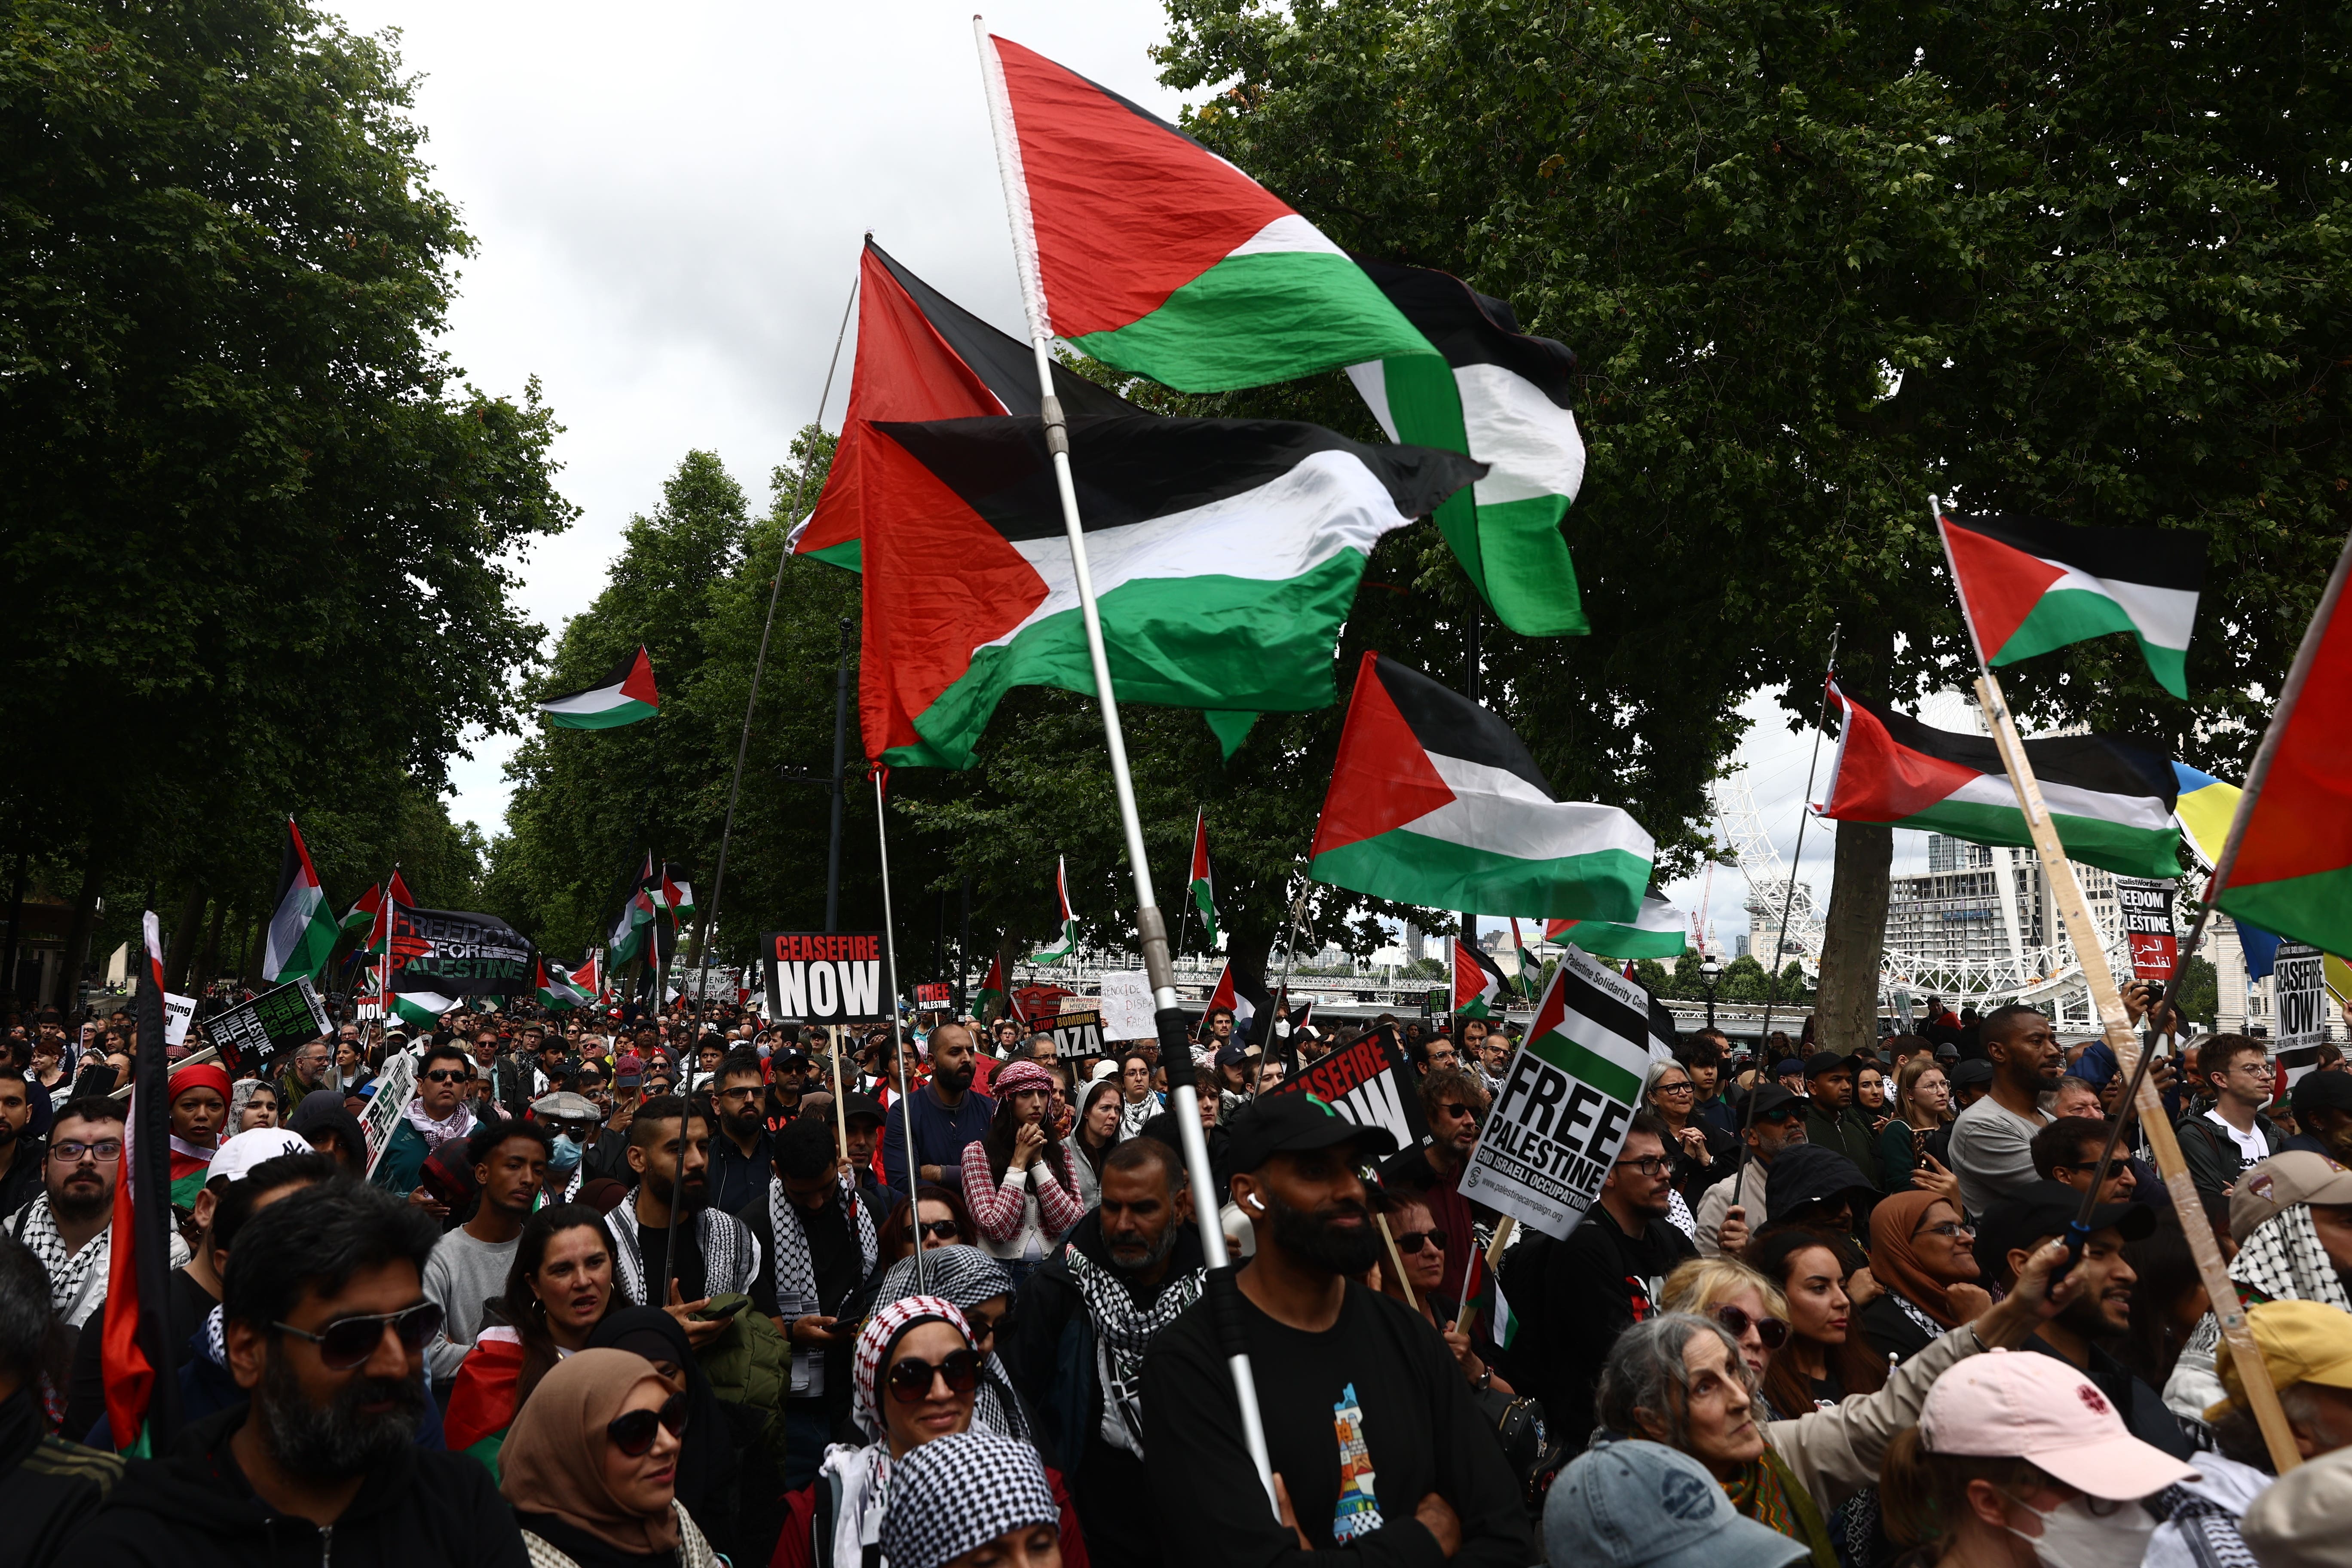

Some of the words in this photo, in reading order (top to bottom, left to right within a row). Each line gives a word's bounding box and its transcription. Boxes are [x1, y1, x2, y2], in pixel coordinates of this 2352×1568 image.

[2123, 914, 2171, 932] LESTINE
[2133, 906, 2143, 914] for
[393, 911, 530, 949] FREEDOM
[435, 941, 481, 959] FOR
[775, 935, 880, 961] CEASEFIRE
[390, 955, 527, 981] PALESTINE
[1566, 953, 1593, 980] Palestine
[1593, 972, 1632, 1002] Solidarity
[2275, 959, 2324, 993] CEASEFIRE
[690, 988, 731, 998] PAESTINE
[777, 960, 880, 1017] NOW
[917, 983, 950, 1002] FREE
[1101, 984, 1141, 997] GENOCIDE
[165, 1002, 192, 1017] rming
[255, 999, 274, 1021] THE
[269, 993, 293, 1023] RIVER
[282, 1021, 299, 1036] TO
[283, 986, 308, 1016] FROM
[297, 1014, 317, 1034] THE
[301, 983, 325, 1025] SocialistWorker
[919, 1000, 951, 1010] PALESTINE
[1126, 998, 1154, 1010] DISEA
[2280, 990, 2321, 1036] NOW!
[208, 1020, 233, 1047] FREE
[224, 1013, 246, 1041] WILL
[236, 1036, 254, 1052] BE
[239, 1006, 275, 1057] PALESTINE
[264, 1018, 283, 1039] SEA
[1033, 1018, 1054, 1032] STOP
[1056, 1012, 1096, 1027] BOMBING
[1054, 1025, 1102, 1058] AZA
[1274, 1034, 1390, 1103] ASEFIRE
[1498, 1053, 1630, 1167] FREE
[1422, 1134, 1434, 1147] FOA
[1484, 1114, 1605, 1194] PALESTINE
[1477, 1148, 1494, 1163] END
[1493, 1155, 1530, 1181] ISRAELI
[1529, 1172, 1589, 1211] OCCUPATION
[1482, 1176, 1564, 1222] www.palestinecampaign.org
